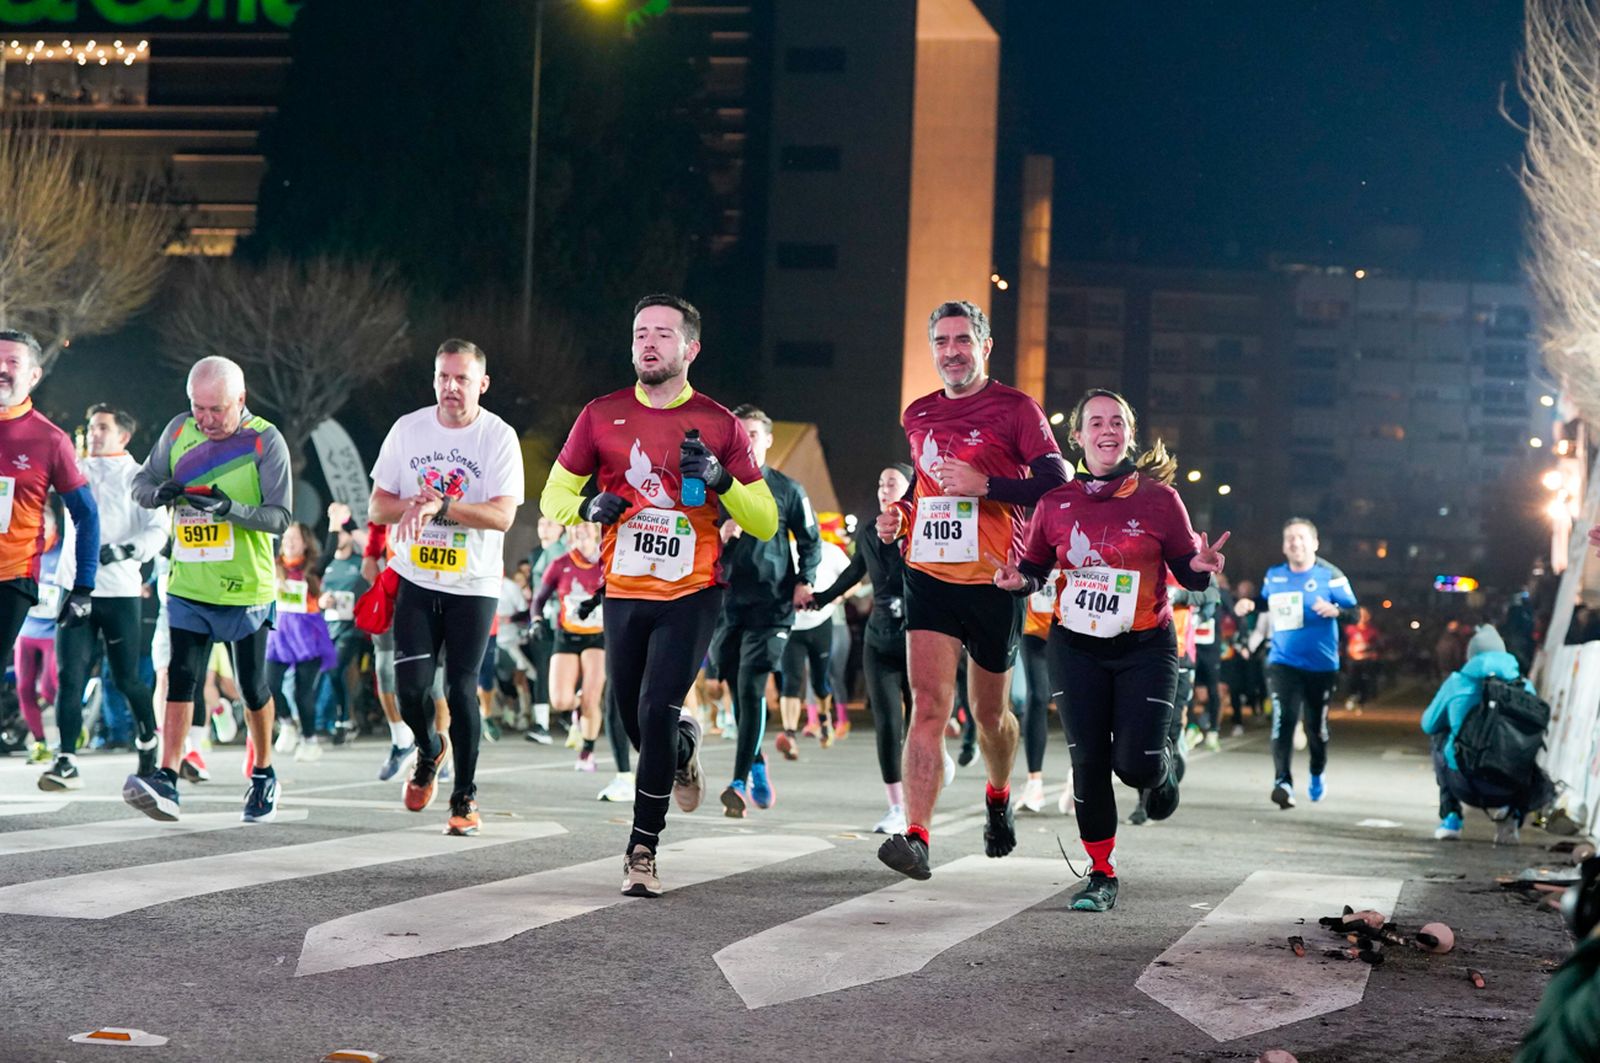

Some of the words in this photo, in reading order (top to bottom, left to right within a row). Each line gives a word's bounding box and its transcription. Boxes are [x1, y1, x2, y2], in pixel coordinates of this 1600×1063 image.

[409, 456, 432, 471] Por
[433, 451, 445, 461] la
[447, 448, 482, 479] Sonrisa
[640, 479, 660, 498] 43
[627, 521, 643, 530] SAN
[637, 514, 660, 524] NOCHE
[661, 517, 670, 526] DE
[184, 525, 218, 542] 5917
[923, 520, 962, 540] 4103
[633, 532, 680, 557] 1850
[420, 546, 457, 566] 6476
[1074, 580, 1087, 588] SAN
[1075, 589, 1120, 615] 4104
